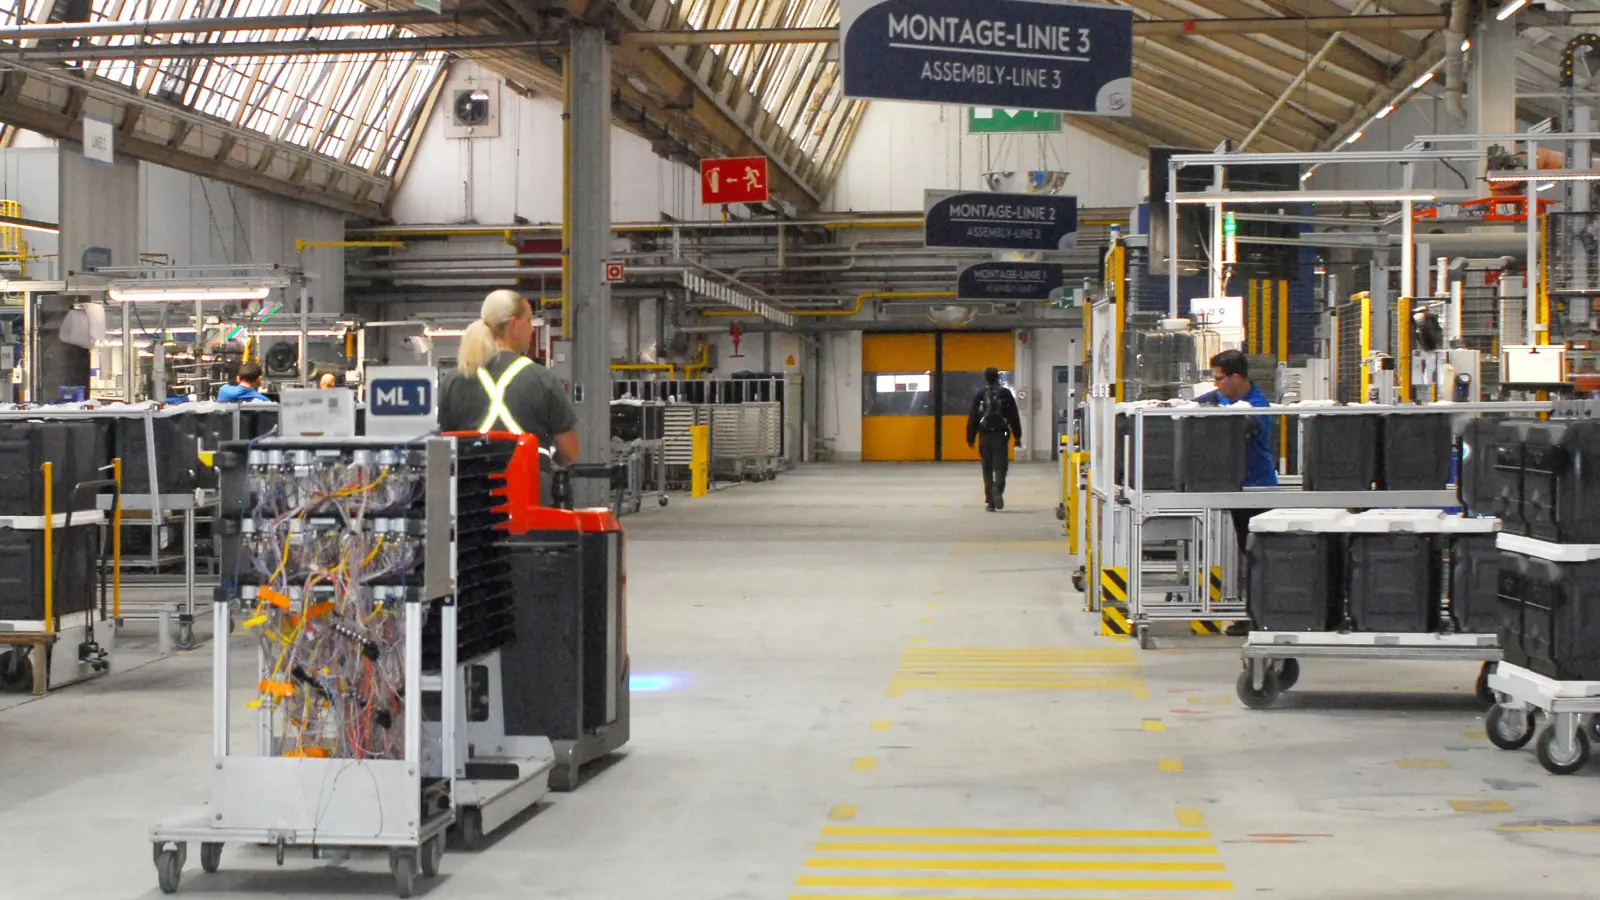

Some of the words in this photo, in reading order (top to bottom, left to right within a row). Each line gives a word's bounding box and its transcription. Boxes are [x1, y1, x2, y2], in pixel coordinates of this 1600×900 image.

[888, 12, 1071, 53] MONTAGE-LINIE
[1077, 28, 1091, 53] 3
[920, 60, 1049, 88] ASSEMBLY-LINE
[1051, 69, 1062, 89] 3
[949, 203, 1046, 221] MONTAGE-LINIE
[1049, 208, 1056, 220] 2
[376, 386, 409, 406] ML
[417, 386, 425, 406] 1
